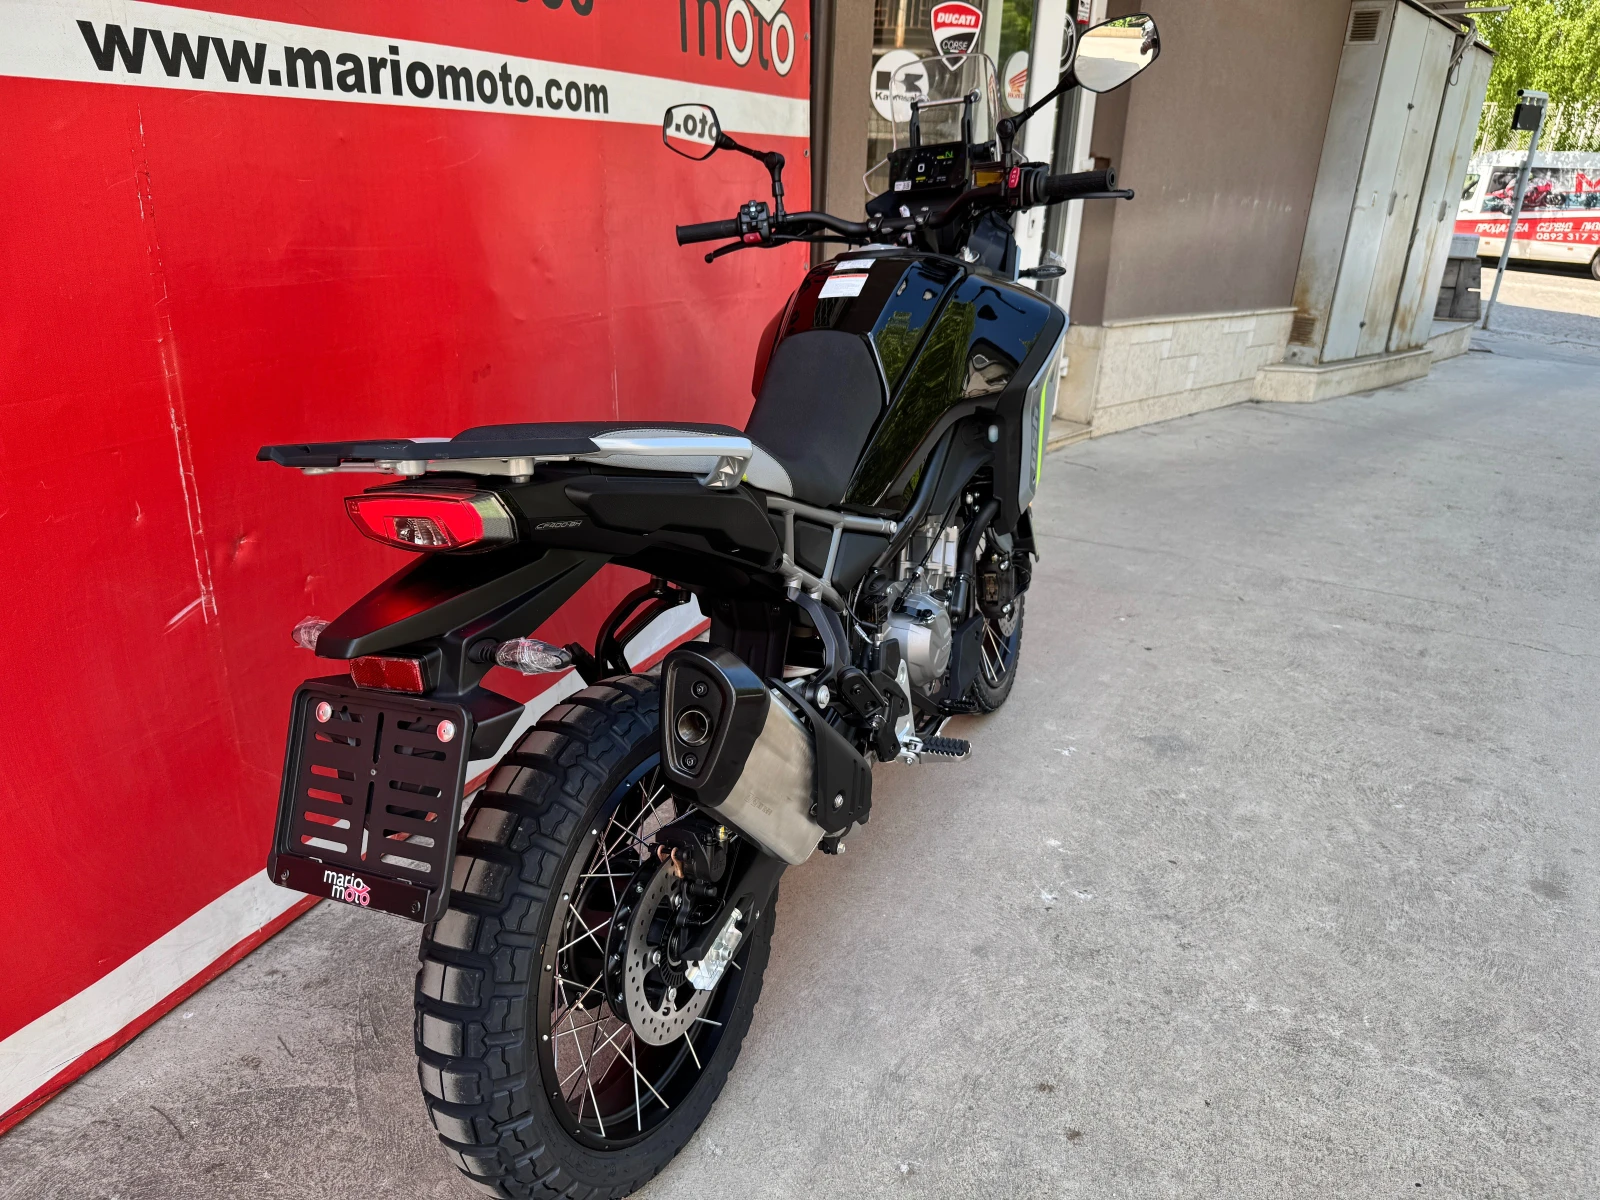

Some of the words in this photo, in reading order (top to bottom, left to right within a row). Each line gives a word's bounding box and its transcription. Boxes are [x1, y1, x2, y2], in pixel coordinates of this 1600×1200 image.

[936, 12, 976, 26] DUCATI
[942, 40, 968, 51] CORSE
[76, 20, 610, 115] www.mariomoto.com
[1474, 222, 1529, 234] ПРОДАБА
[1536, 232, 1564, 241] 0892
[1566, 232, 1589, 241] 317
[323, 870, 364, 890] mario
[331, 884, 371, 906] moto
